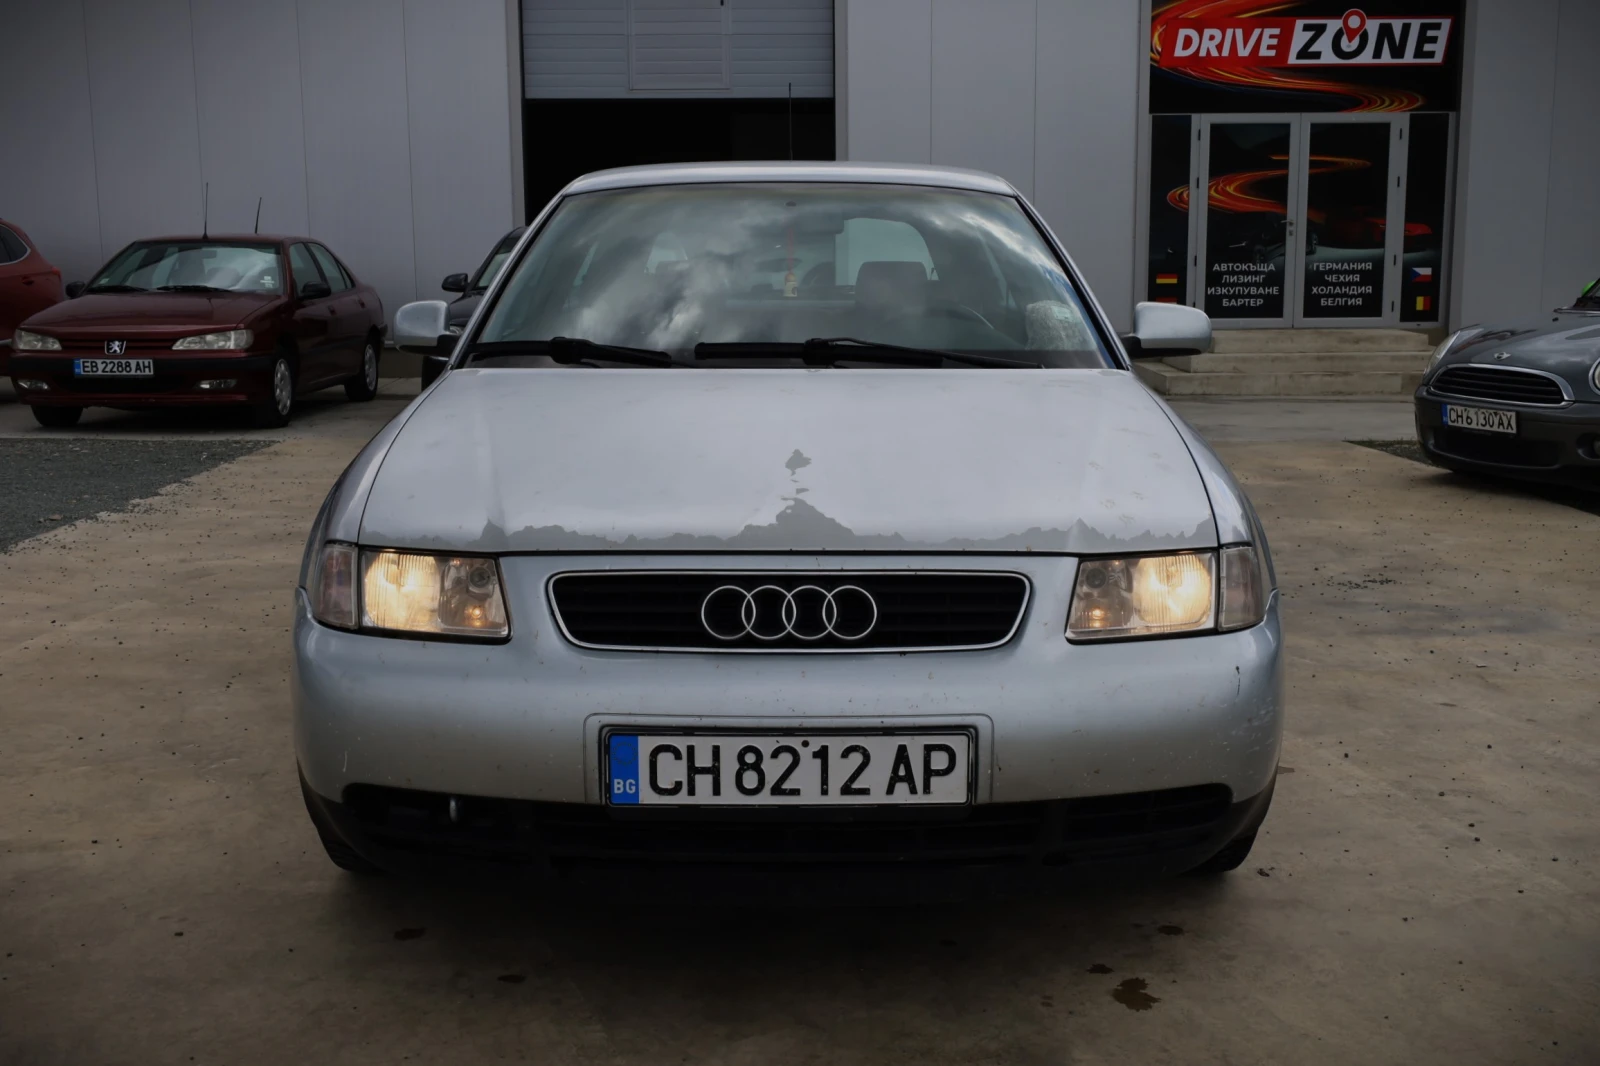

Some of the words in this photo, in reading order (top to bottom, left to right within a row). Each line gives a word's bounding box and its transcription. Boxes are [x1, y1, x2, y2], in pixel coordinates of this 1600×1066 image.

[1173, 27, 1281, 58] DRIVE
[1295, 22, 1443, 60] ZONE
[1212, 263, 1276, 272] АВТОКЪЩА
[1313, 262, 1373, 271] ГЕРМАНИЯ
[1222, 275, 1266, 283] ЛИЗИНГ
[1324, 274, 1360, 282] ЧЕХИЯ
[1207, 286, 1280, 295] ИЗКУПУВАНЕ
[1311, 286, 1373, 295] ХОЛАНДИЯ
[1222, 298, 1264, 307] БАРТЕР
[1320, 298, 1363, 306] БЕЛГИЯ
[81, 360, 99, 373] EB
[101, 360, 132, 373] 2288
[134, 360, 152, 373] AH
[1449, 407, 1464, 425] CH
[1466, 409, 1495, 428] 6130
[1497, 413, 1514, 431] AX
[648, 743, 721, 796] CH
[734, 743, 872, 796] 8212
[885, 743, 957, 796] AP
[613, 778, 636, 795] BG
